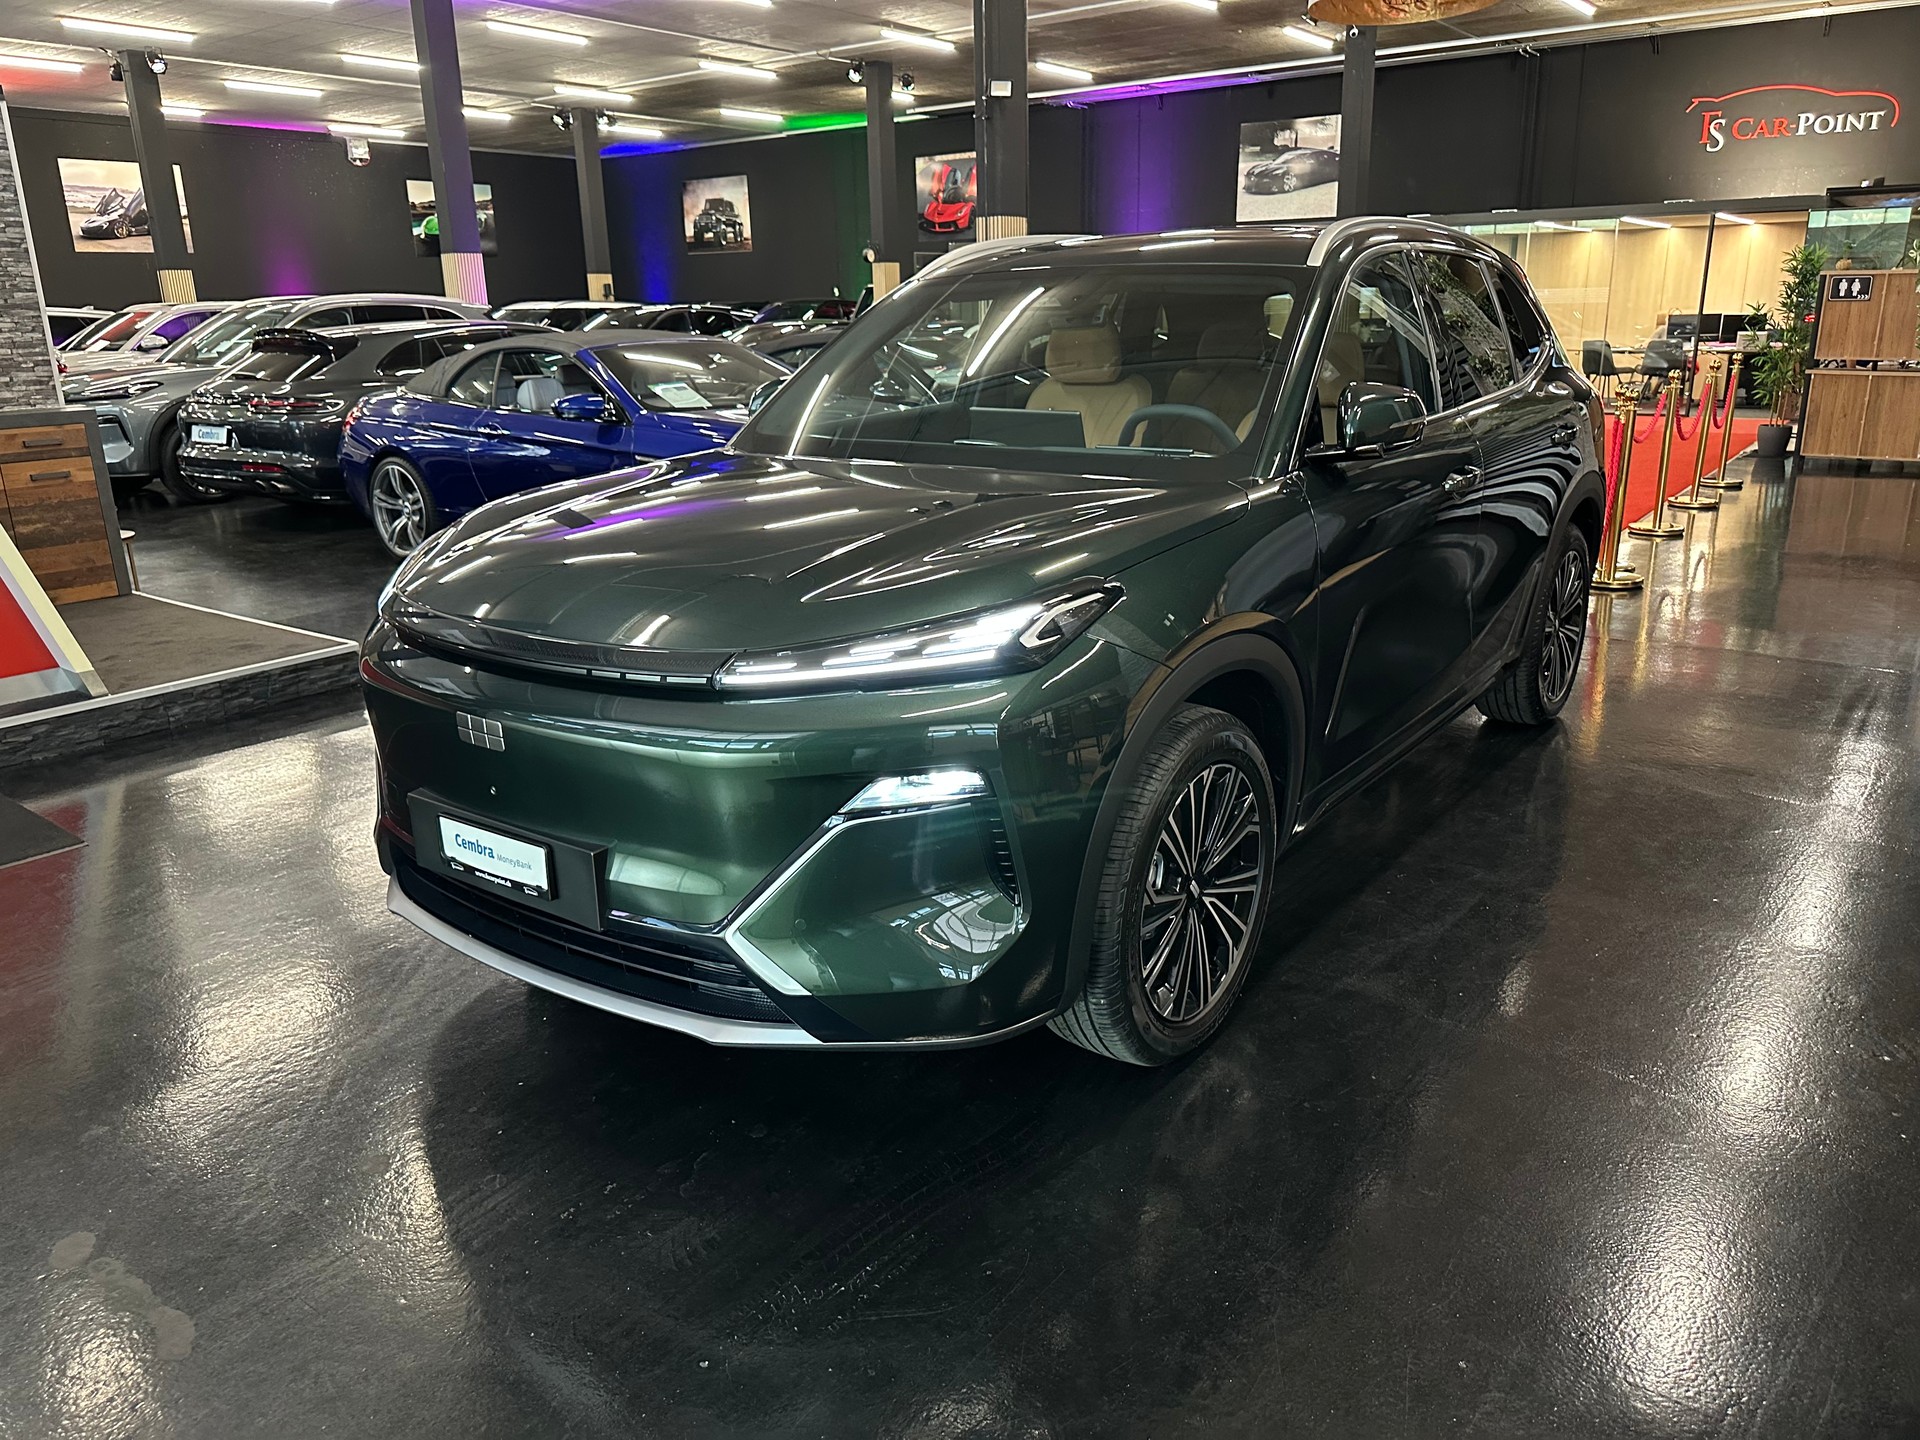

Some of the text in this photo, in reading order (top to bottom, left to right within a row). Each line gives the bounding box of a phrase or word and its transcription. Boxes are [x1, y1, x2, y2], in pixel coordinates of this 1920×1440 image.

[1699, 110, 1887, 153] FS CAR-POINT
[198, 428, 220, 440] Cembra
[455, 833, 533, 871] Cembra MoneyBank
